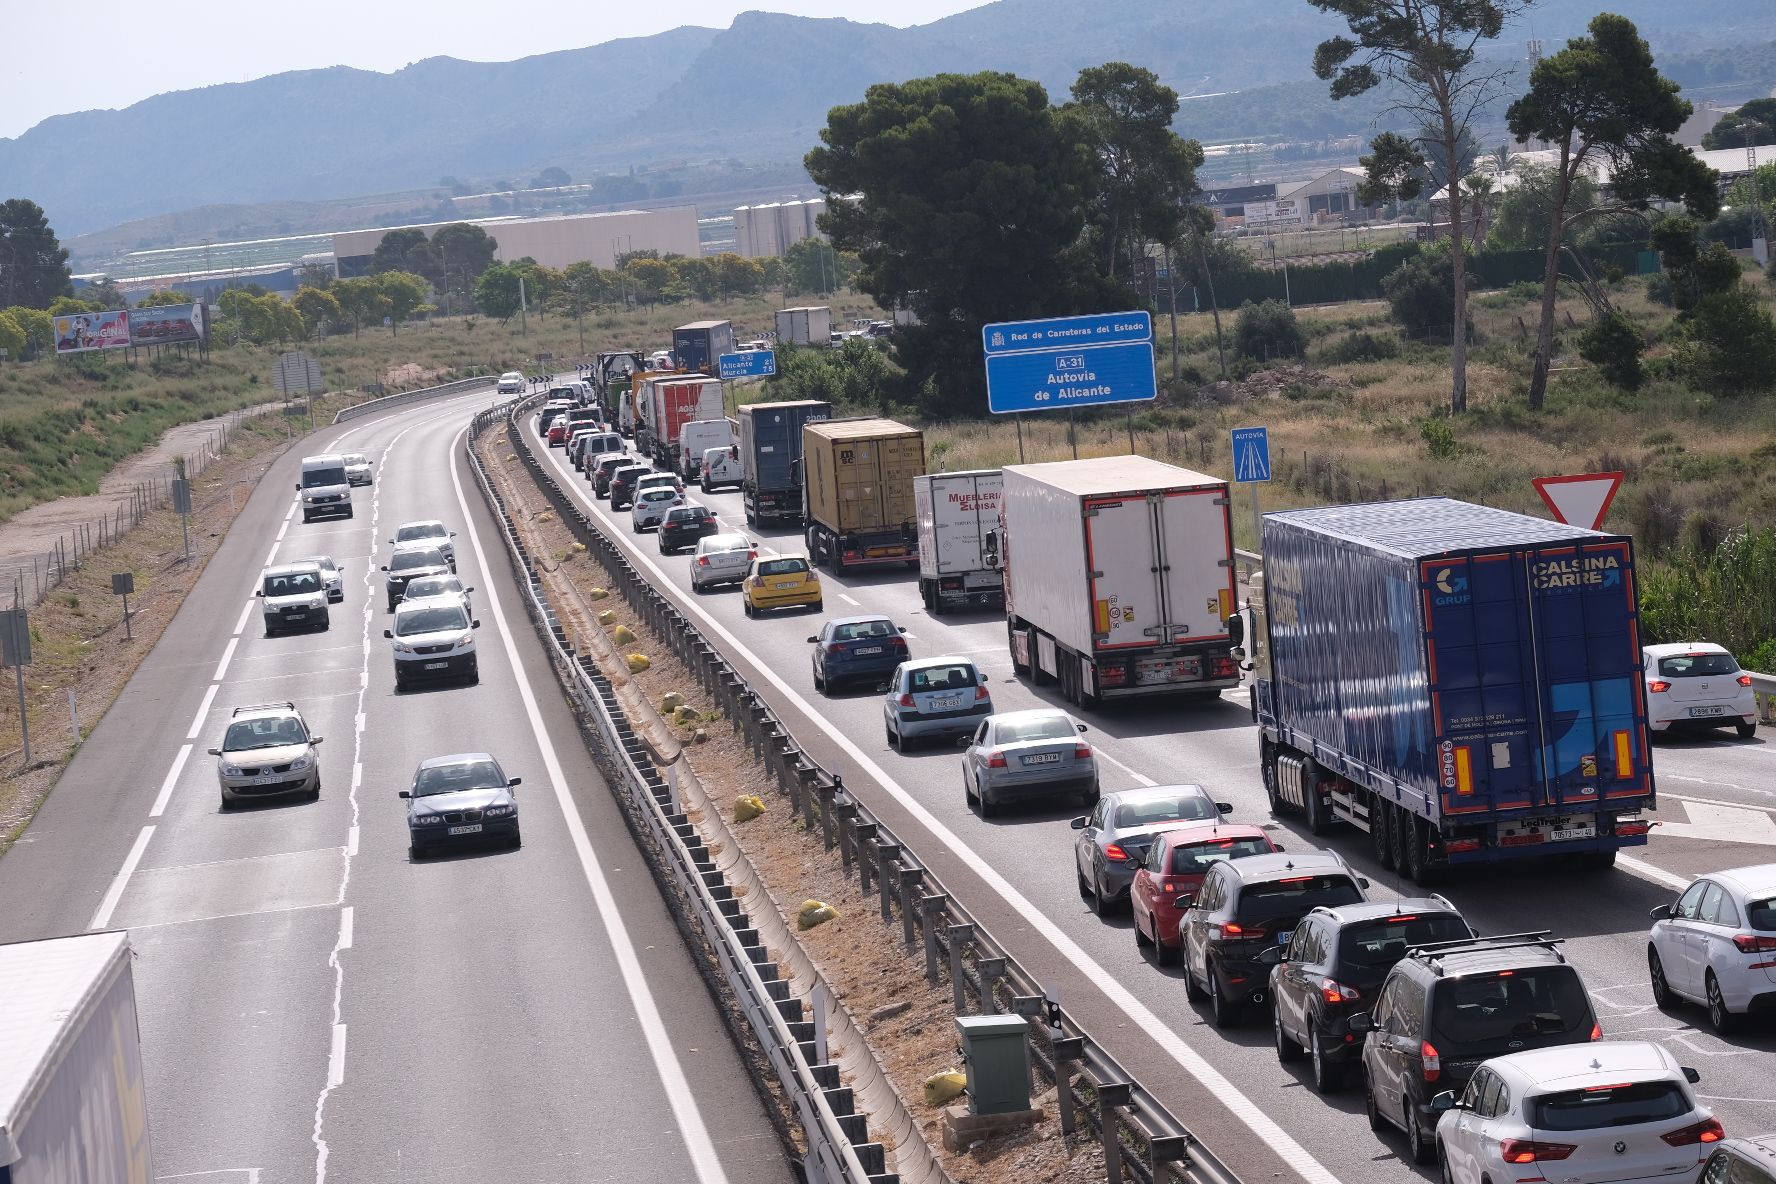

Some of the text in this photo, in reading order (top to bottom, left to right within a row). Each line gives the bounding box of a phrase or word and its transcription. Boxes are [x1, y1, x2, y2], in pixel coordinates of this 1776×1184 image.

[1011, 333, 1028, 341] Red
[1047, 328, 1092, 338] Carreteras
[1114, 323, 1144, 332] Estado
[722, 361, 753, 370] Alicante
[1059, 358, 1083, 368] A-31
[1034, 385, 1112, 401] de Alicante
[1533, 556, 1619, 576] CALSINA
[1533, 572, 1603, 589] CARRE
[1435, 594, 1472, 606] GRUP
